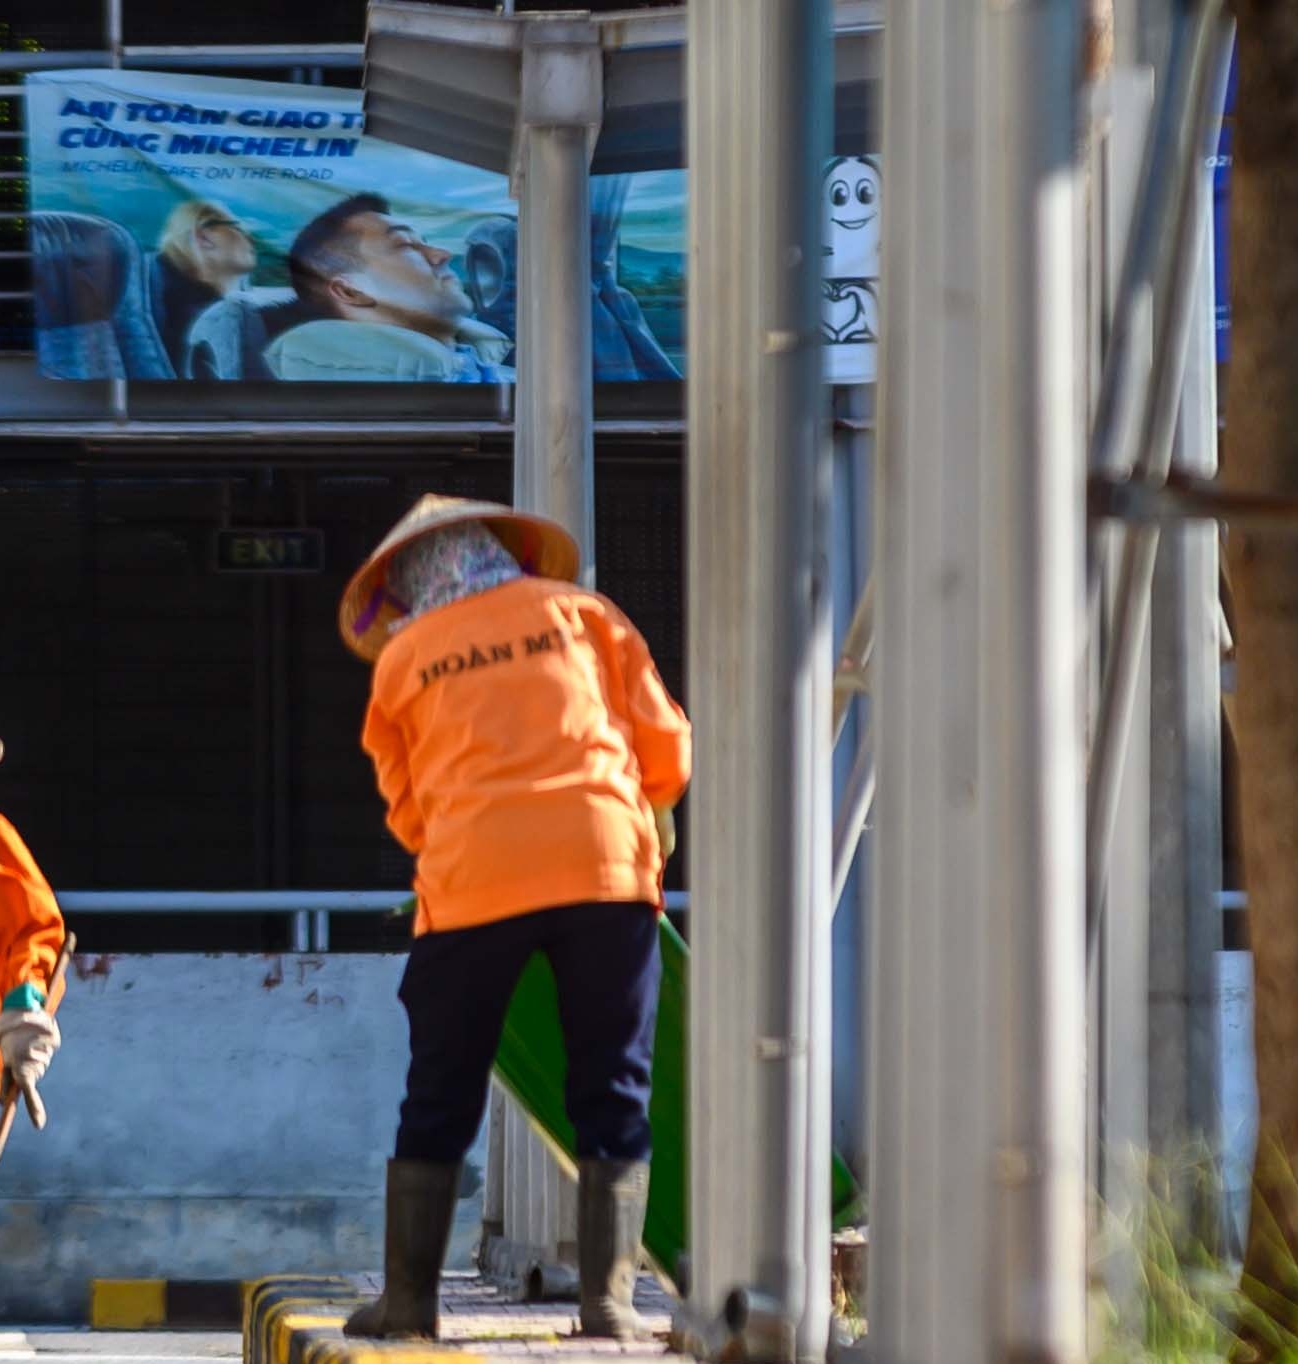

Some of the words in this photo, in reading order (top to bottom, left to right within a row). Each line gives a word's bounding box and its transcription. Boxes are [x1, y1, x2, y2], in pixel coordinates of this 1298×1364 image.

[59, 97, 116, 122] AN
[236, 110, 330, 129] GIAO
[168, 133, 360, 157] MICHELIN
[61, 159, 157, 175] MICHELIN
[160, 164, 203, 179] SAFE
[204, 165, 236, 181] ON
[240, 166, 279, 181] THE
[281, 166, 334, 182] ROAD
[229, 537, 306, 563] EXIT
